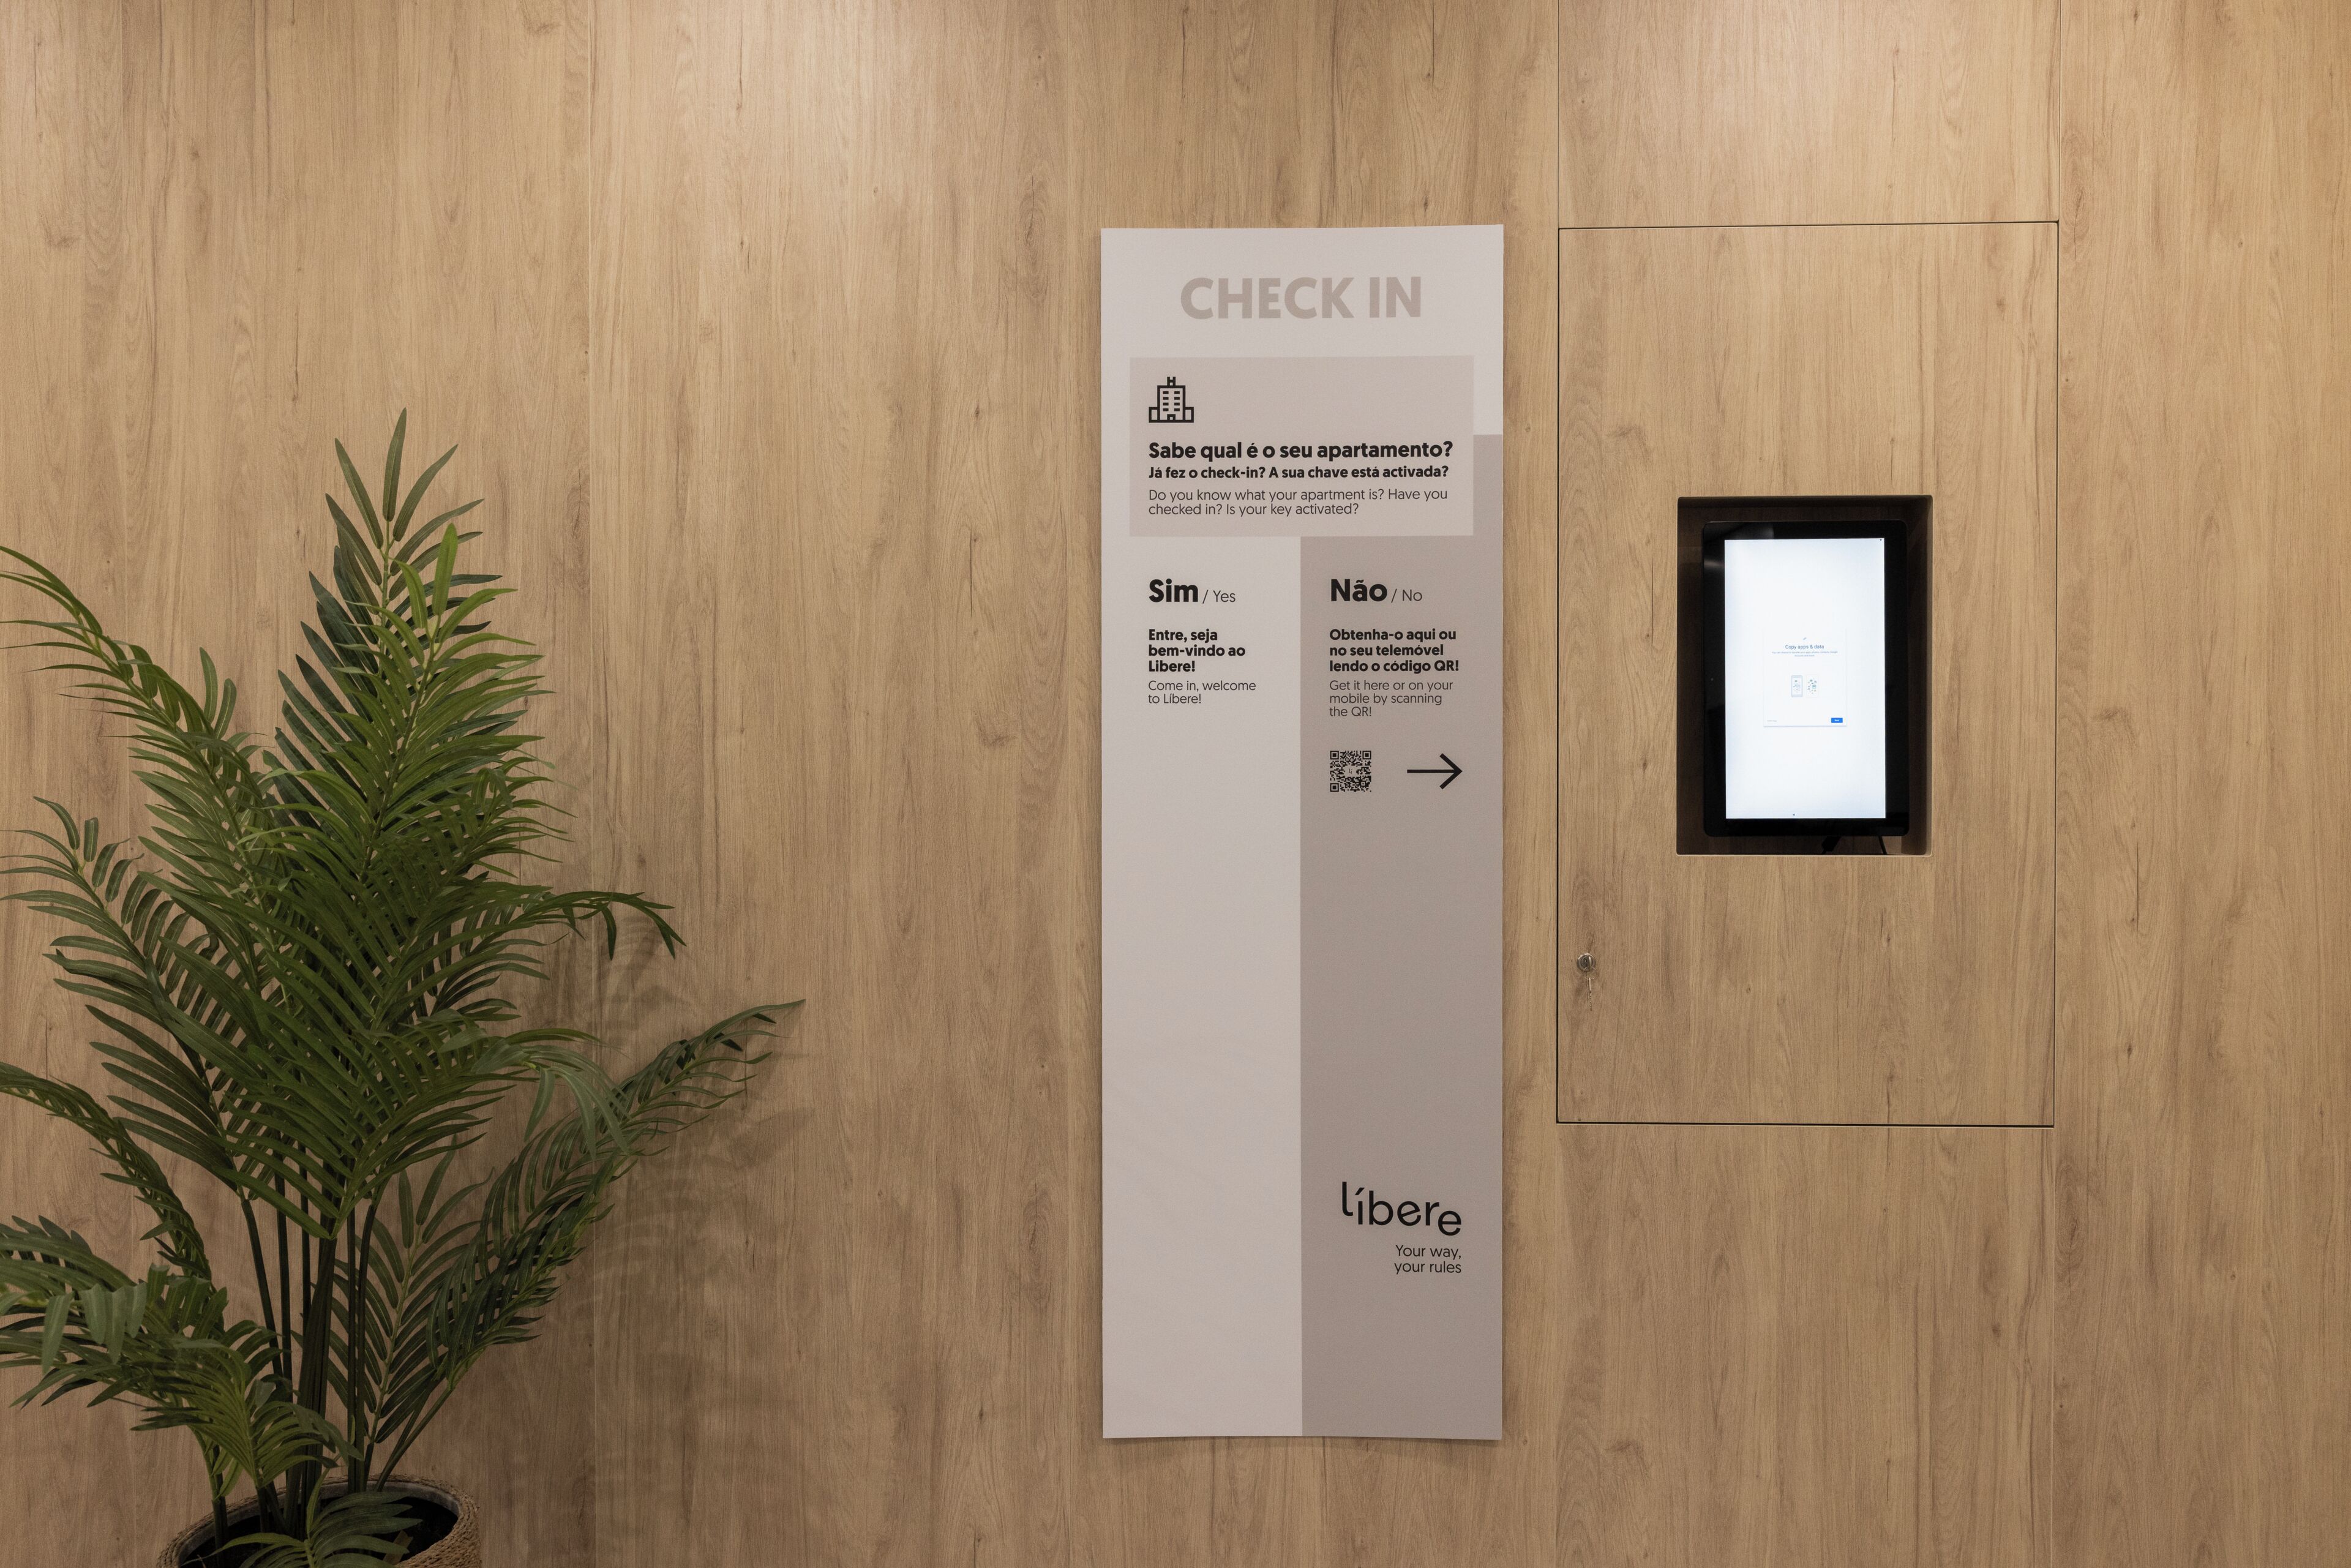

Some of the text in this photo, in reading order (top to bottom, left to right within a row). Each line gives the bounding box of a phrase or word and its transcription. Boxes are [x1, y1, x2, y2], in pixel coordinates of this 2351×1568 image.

[1180, 276, 1421, 320] CHECK IN
[1149, 440, 1453, 463] Sabe qual é o seu apartamento?
[1148, 465, 1449, 479] Já fez o check-in? A sua chave está activada?
[1149, 488, 1447, 503] Do you know what your apartment is? Have you
[1148, 503, 1359, 517] checked in? Is your key activated?
[1148, 578, 1236, 604] Sim / Yes
[1330, 578, 1423, 604] Não / No
[1149, 628, 1218, 644] Entre, seja
[1329, 628, 1457, 643] Obtenha-o aqui ou
[1148, 643, 1246, 657] bem-vindo ao
[1329, 643, 1444, 656] no seu telemóvel
[1149, 659, 1196, 672] Libere!
[1329, 659, 1459, 675] lendo o código QR!
[1148, 680, 1256, 692] Come in, welcome
[1329, 680, 1453, 692] Get it here or on your
[1147, 692, 1201, 704] to Líbere!
[1329, 692, 1442, 706] mobile by scanning
[1329, 706, 1372, 717] the QR!
[1341, 1181, 1462, 1236] líbere
[1395, 1244, 1461, 1261] Your way,
[1393, 1260, 1462, 1275] your rules
